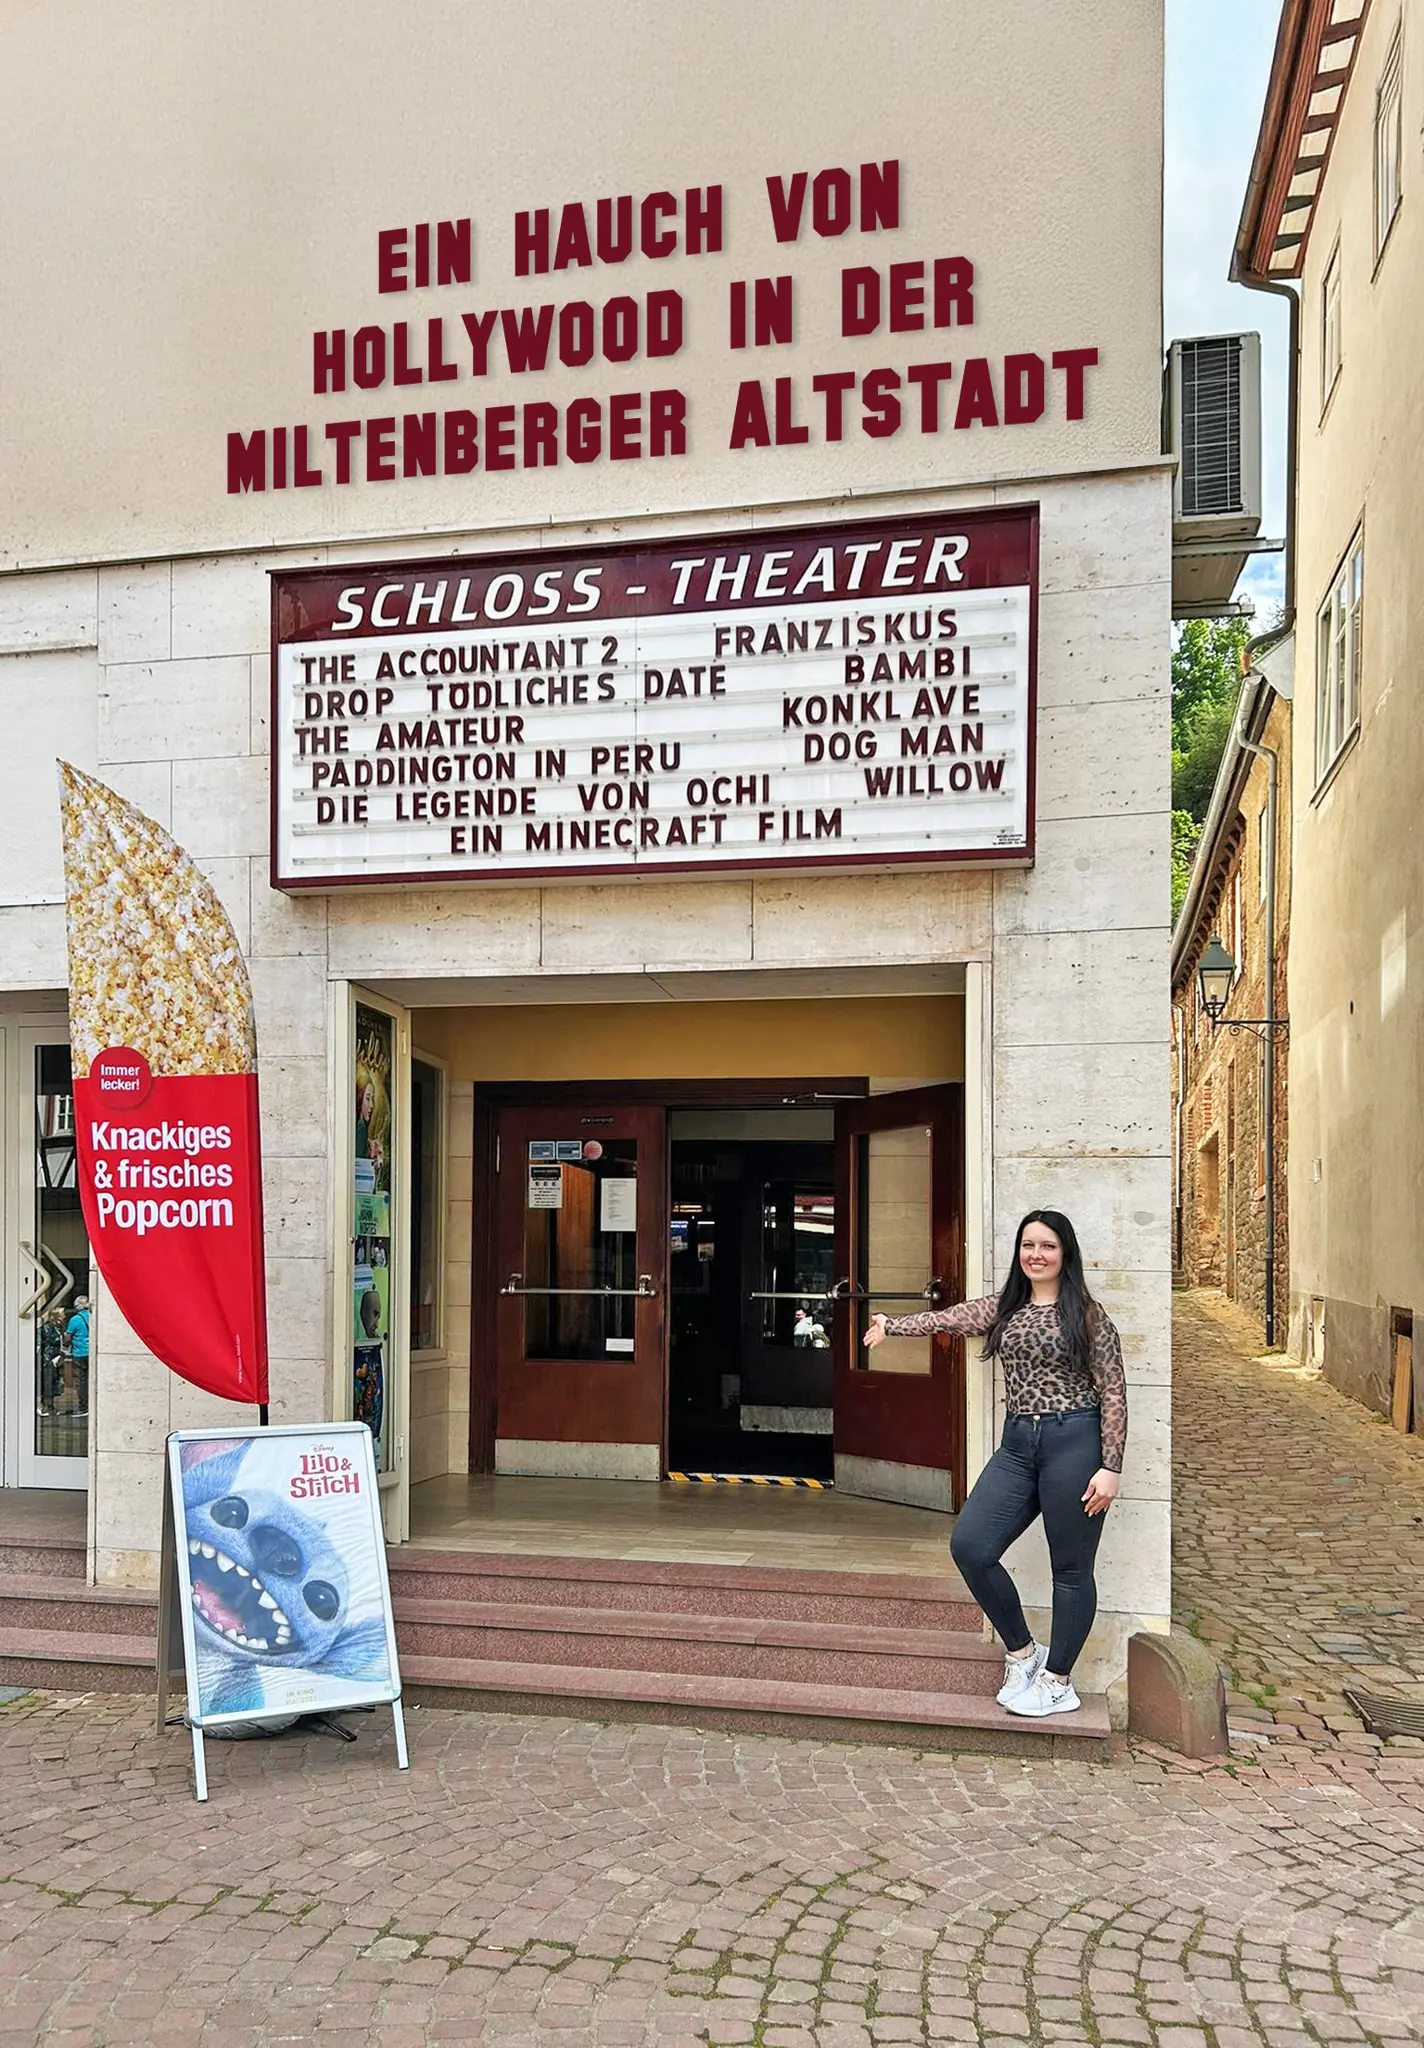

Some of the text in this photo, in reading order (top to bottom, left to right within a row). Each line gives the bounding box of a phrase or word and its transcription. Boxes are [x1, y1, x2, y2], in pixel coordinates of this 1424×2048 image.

[331, 567, 603, 631] SCHLOSS
[670, 535, 969, 605] THEATER
[715, 609, 958, 658] FRANZISKUS
[300, 635, 618, 686] THE ACCOUNTANT 2
[845, 645, 971, 686] BAMBI
[305, 687, 394, 721] DROP
[644, 665, 726, 700] DATE
[783, 684, 980, 728] KONKLAVE
[295, 715, 525, 756] THE AMATEUR
[804, 722, 983, 764] DOG MAN
[312, 741, 681, 790] PADDINGTON IN PERU
[864, 759, 1005, 799] WILLOW
[317, 773, 770, 825] DIE LEGENDE VON OCHI
[451, 807, 842, 855] EIN MINECRAFT FILM
[100, 1063, 140, 1076] Immer
[100, 1078, 140, 1091] lecker!
[91, 1120, 232, 1156] Knackiges
[94, 1158, 233, 1189] & frisches
[96, 1192, 234, 1236] Popcorn
[299, 1454, 352, 1475] Lilo &
